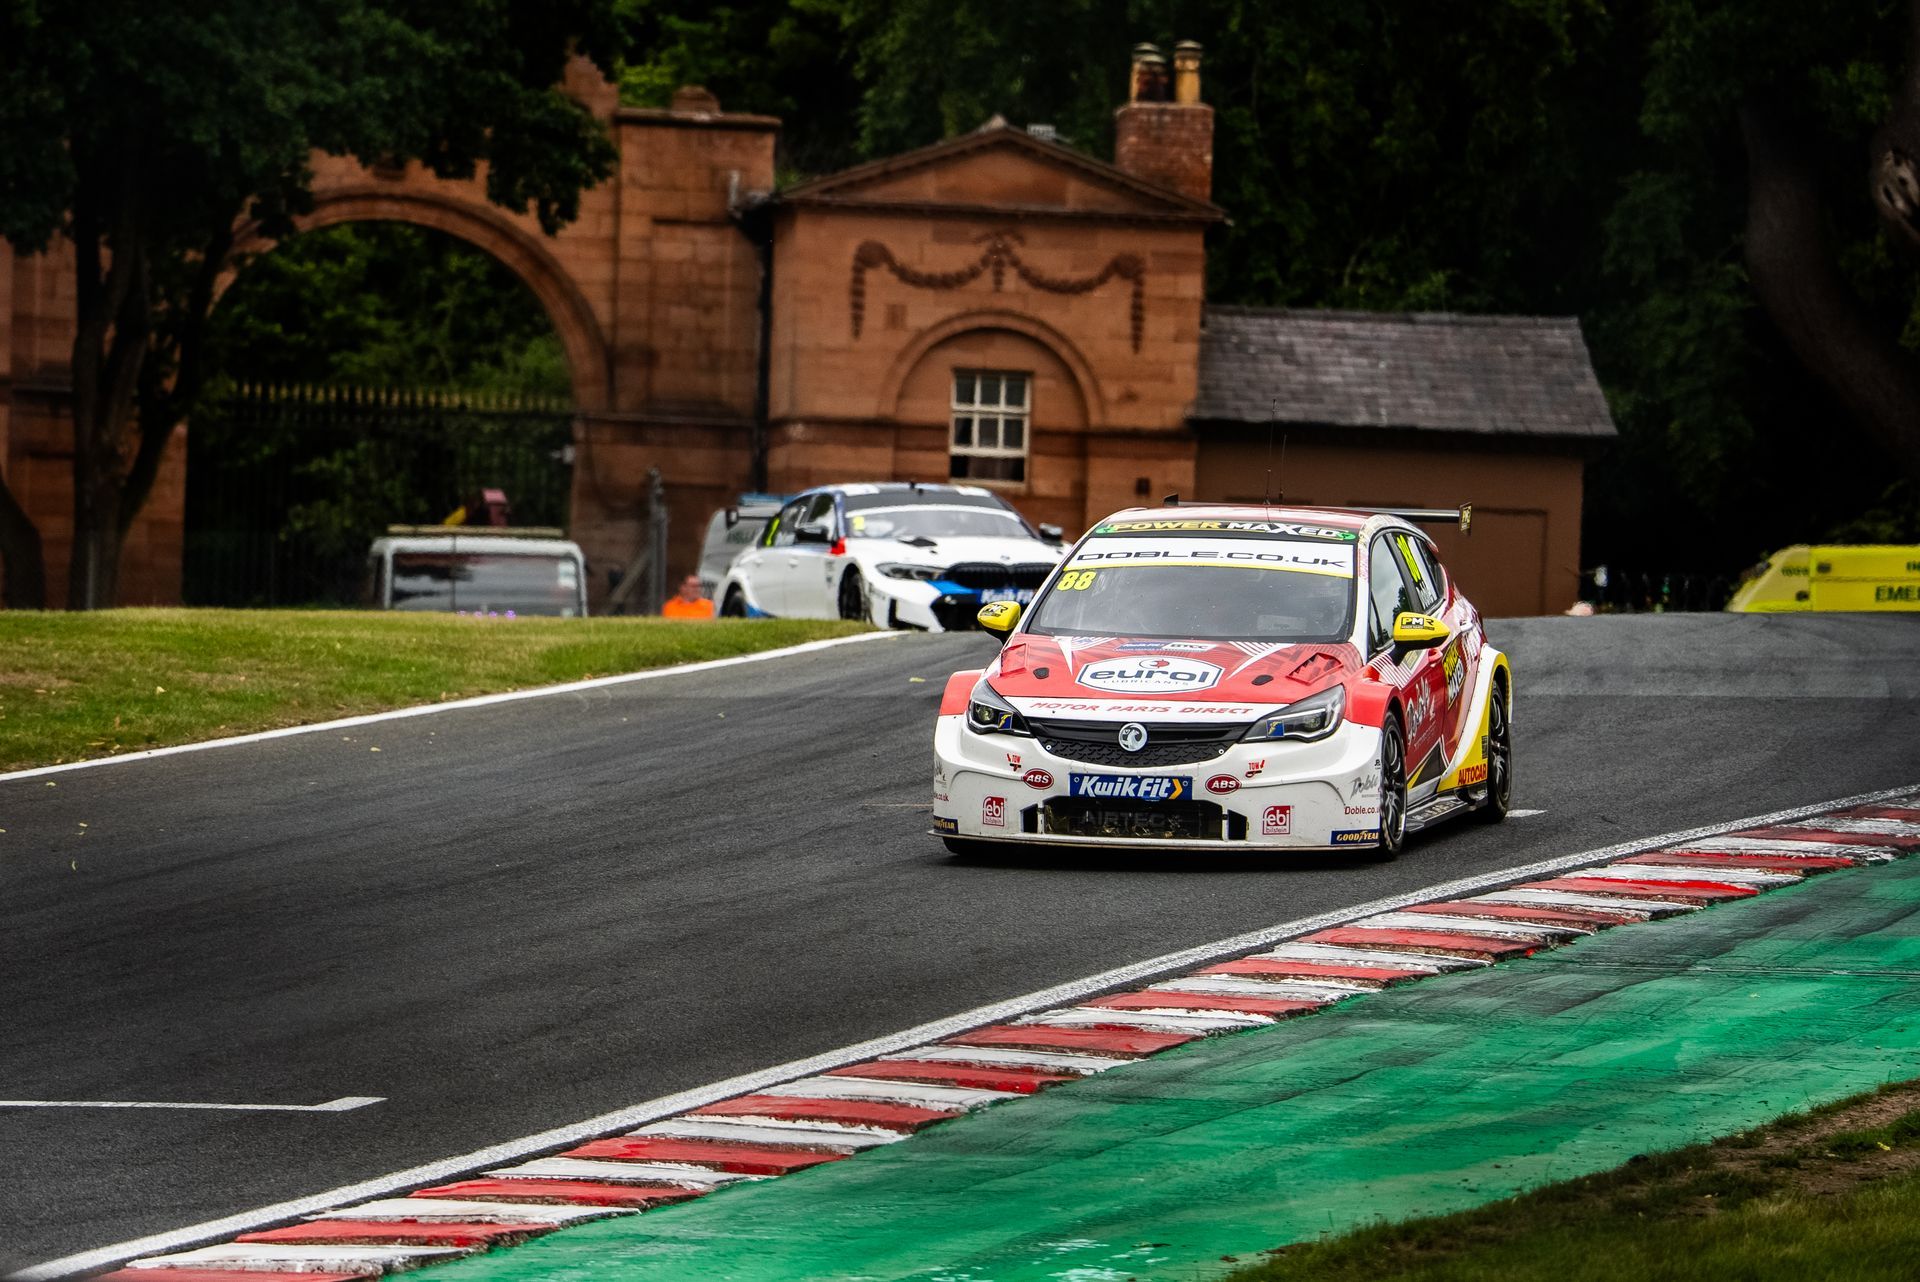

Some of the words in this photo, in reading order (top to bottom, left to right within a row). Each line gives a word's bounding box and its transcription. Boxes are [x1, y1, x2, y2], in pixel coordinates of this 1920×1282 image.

[1112, 520, 1223, 533] POWER
[1076, 550, 1348, 568] DOBLE.CO.UK
[1055, 571, 1097, 592] 88
[1089, 667, 1210, 683] eurol
[1030, 702, 1100, 712] MOTOR
[1104, 705, 1172, 713] PARTS
[1178, 706, 1254, 715] DIRECT
[1248, 762, 1260, 770] TOW
[1026, 774, 1050, 784] ABS
[1457, 763, 1488, 786] AUTOCAR
[1211, 780, 1237, 789] ABS
[983, 797, 1004, 818] febi
[1263, 807, 1290, 826] febi
